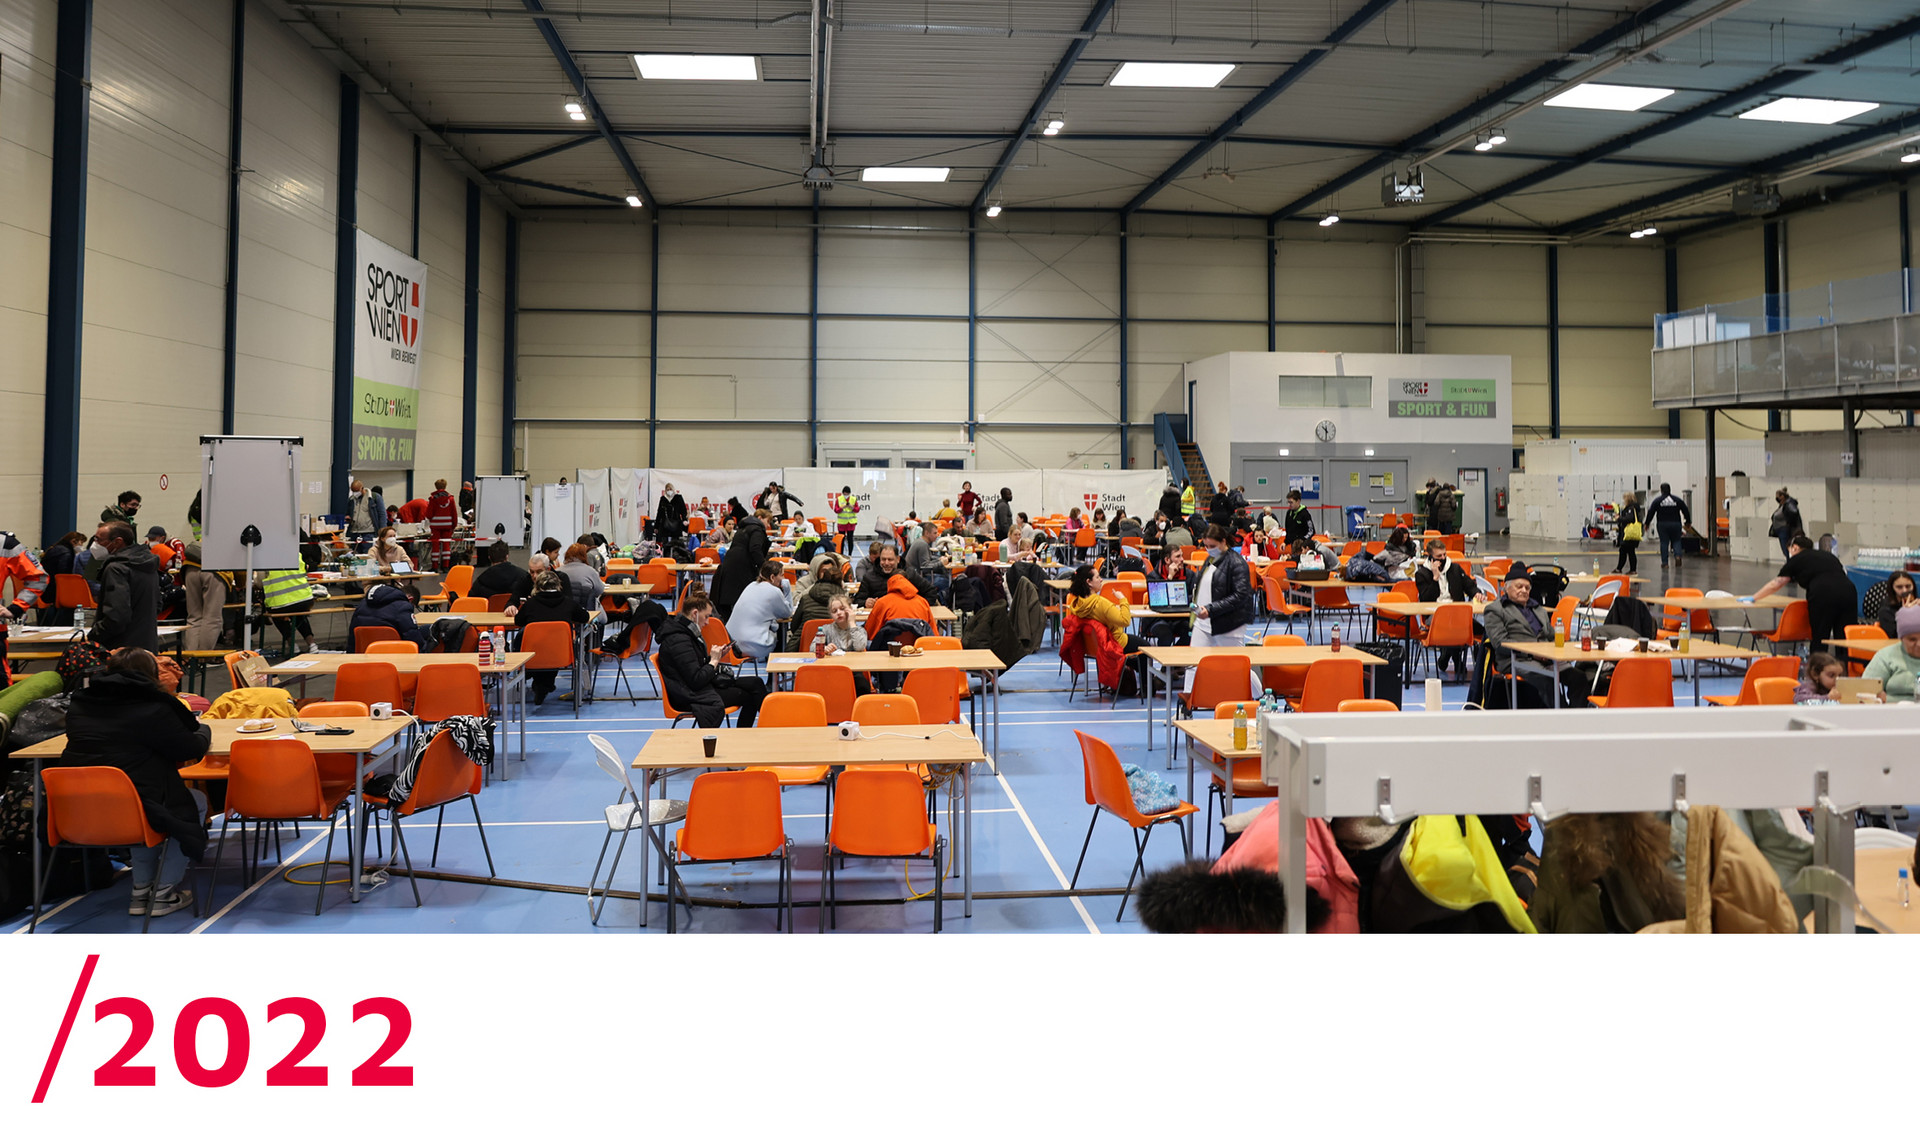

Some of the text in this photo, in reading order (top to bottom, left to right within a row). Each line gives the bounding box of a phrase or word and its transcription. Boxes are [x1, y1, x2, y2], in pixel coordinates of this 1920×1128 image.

[367, 262, 409, 313] SPORT
[366, 301, 401, 344] WIEN
[1402, 381, 1422, 389] SPORT
[1397, 402, 1488, 416] SPORT & FUN
[357, 434, 414, 461] SPORT & FUN
[978, 493, 1000, 502] tadt
[1101, 493, 1126, 502] Stadt
[1101, 502, 1126, 511] Wien
